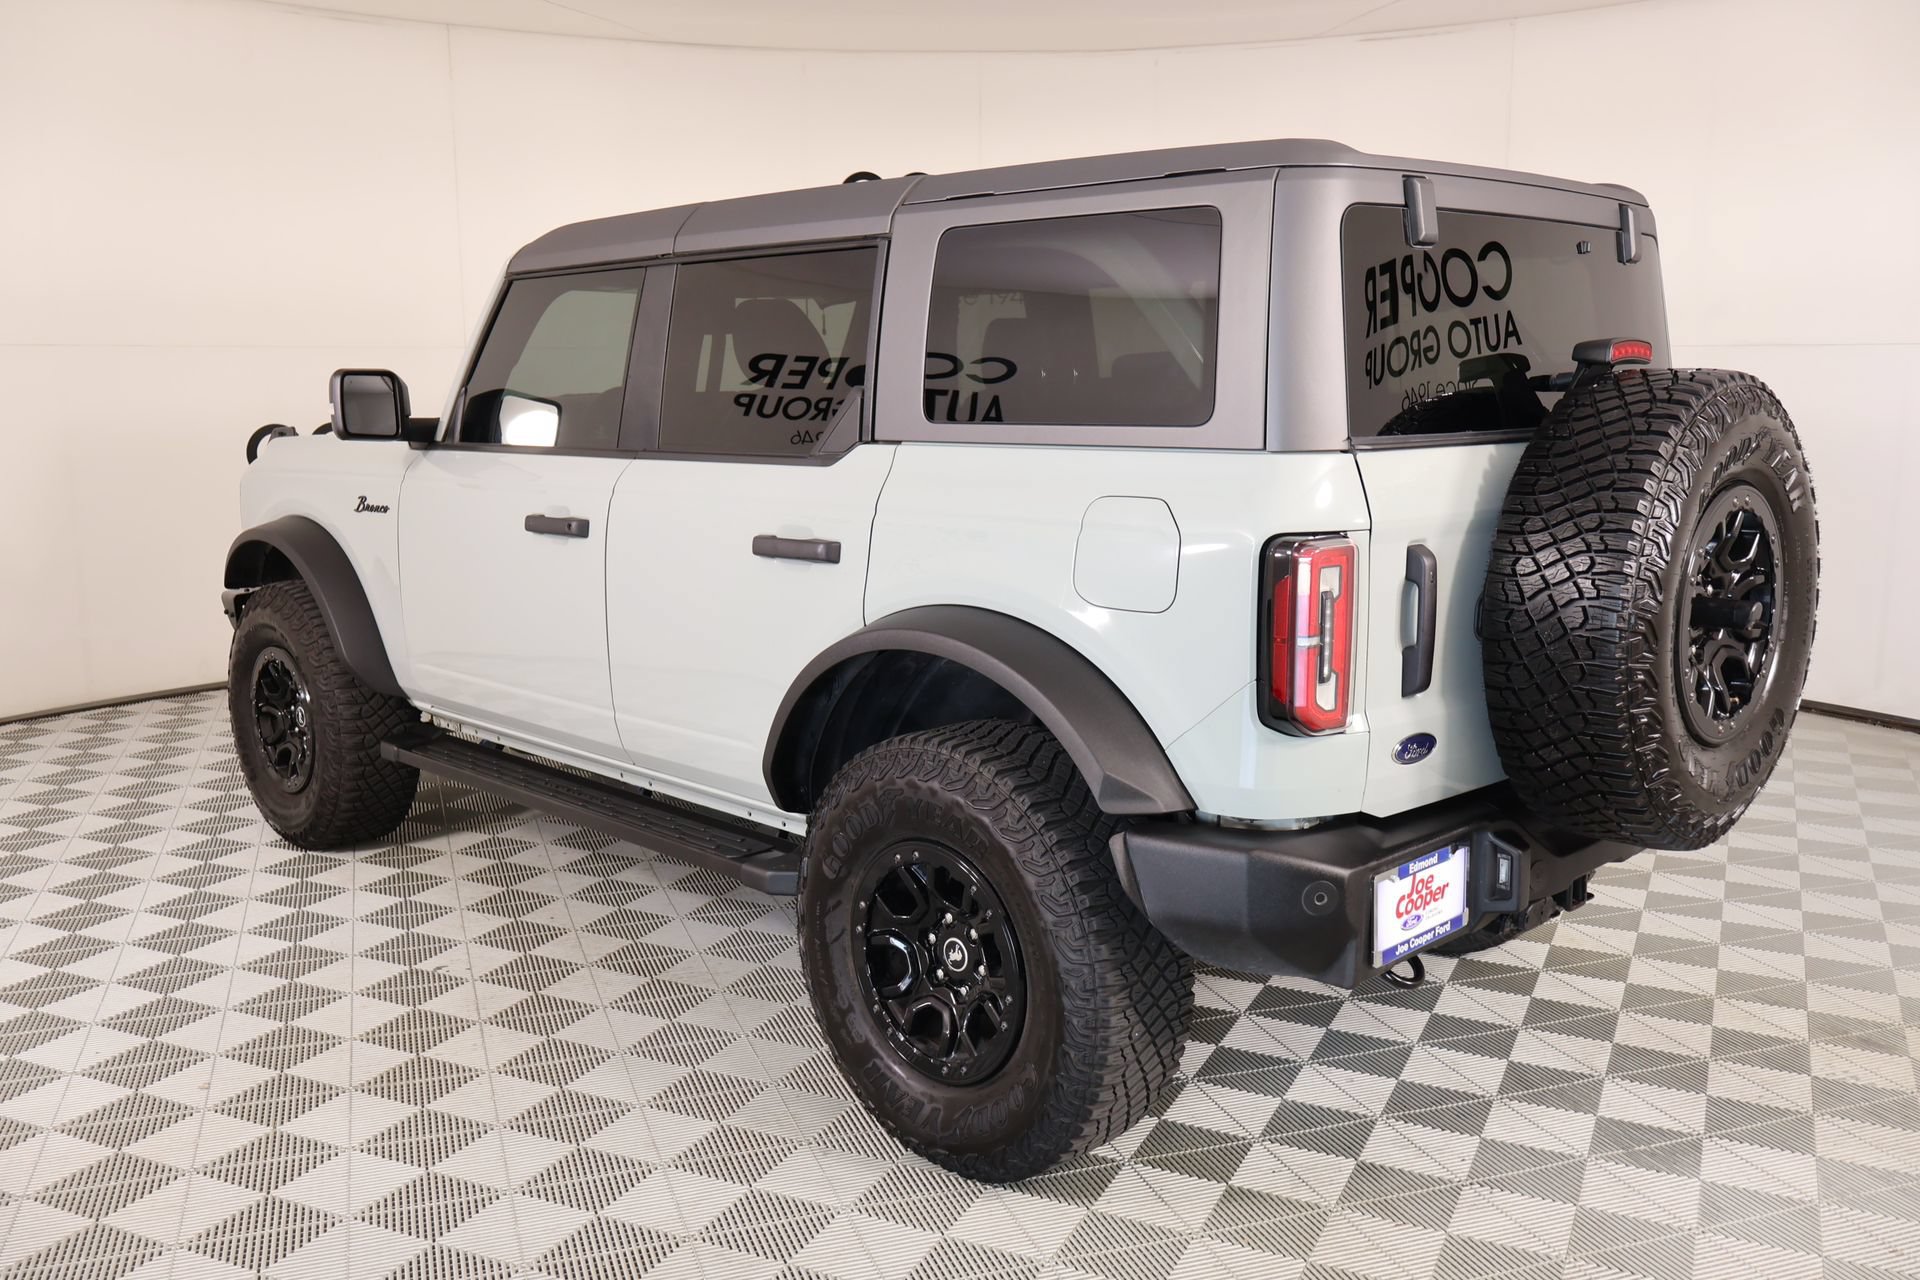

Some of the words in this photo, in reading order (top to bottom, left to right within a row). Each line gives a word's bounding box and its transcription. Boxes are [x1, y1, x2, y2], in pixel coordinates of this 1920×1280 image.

[354, 495, 390, 514] Bronco
[1409, 853, 1438, 874] Edmond
[1407, 872, 1434, 899] Joe
[1396, 882, 1449, 919] Cooper
[1395, 942, 1409, 956] Joe
[1409, 929, 1434, 949] Cooper
[1435, 921, 1451, 938] Ford
